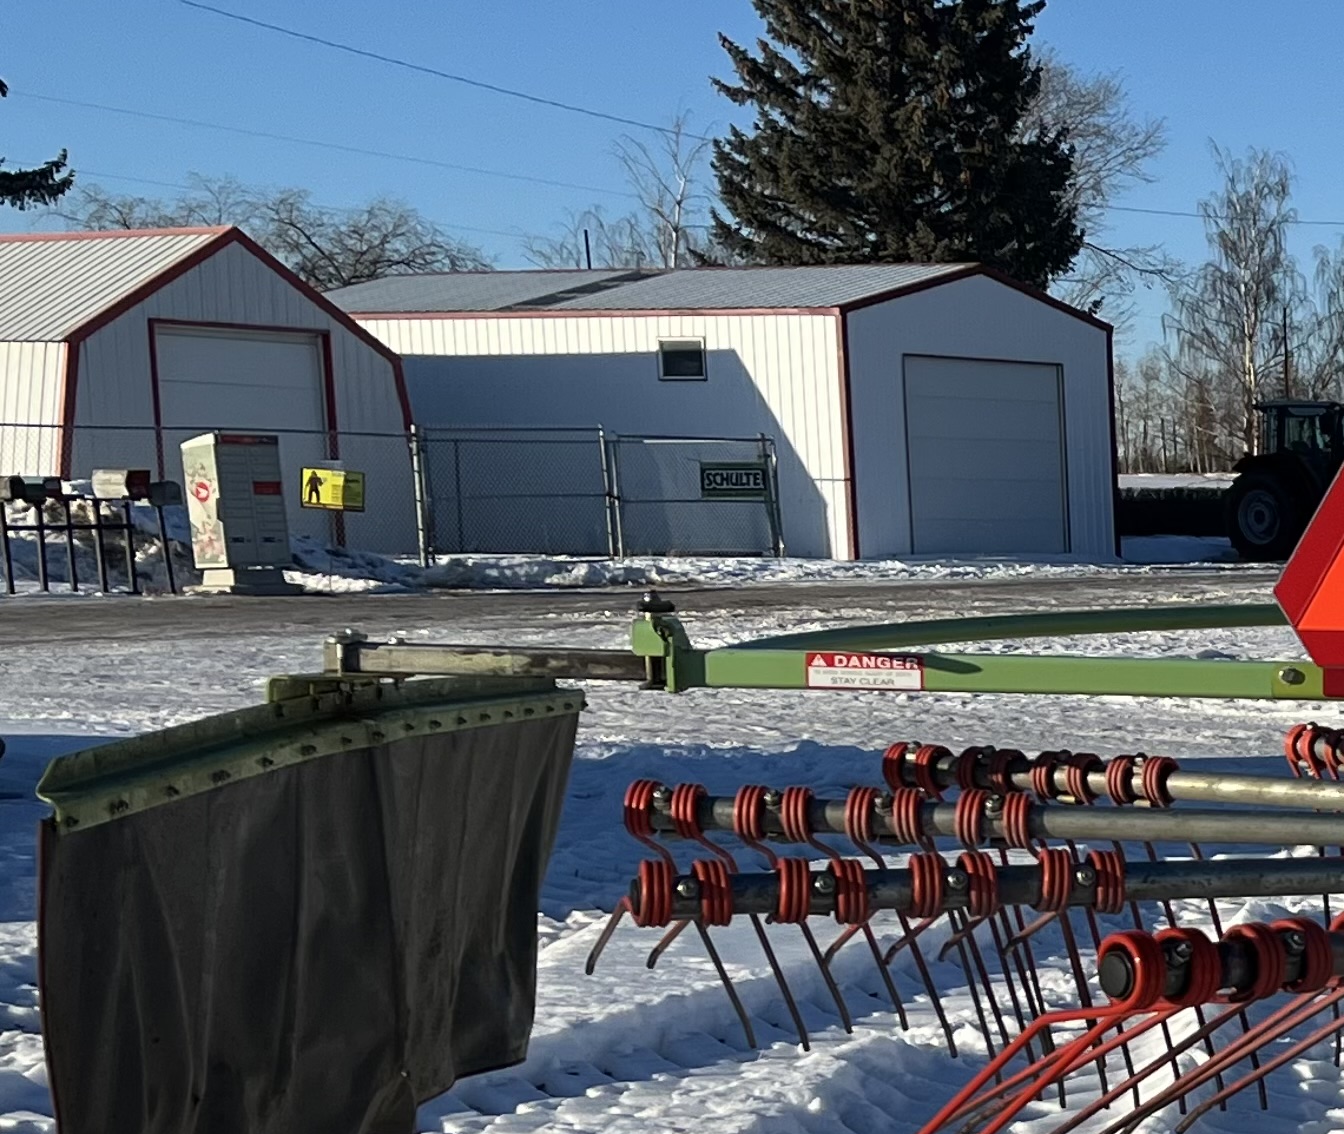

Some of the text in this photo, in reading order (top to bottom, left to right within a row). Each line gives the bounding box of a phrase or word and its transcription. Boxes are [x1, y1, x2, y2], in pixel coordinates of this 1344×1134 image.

[705, 472, 761, 487] SCHULTE
[833, 655, 918, 669] DANGER
[830, 676, 895, 686] STAY CLEAR
